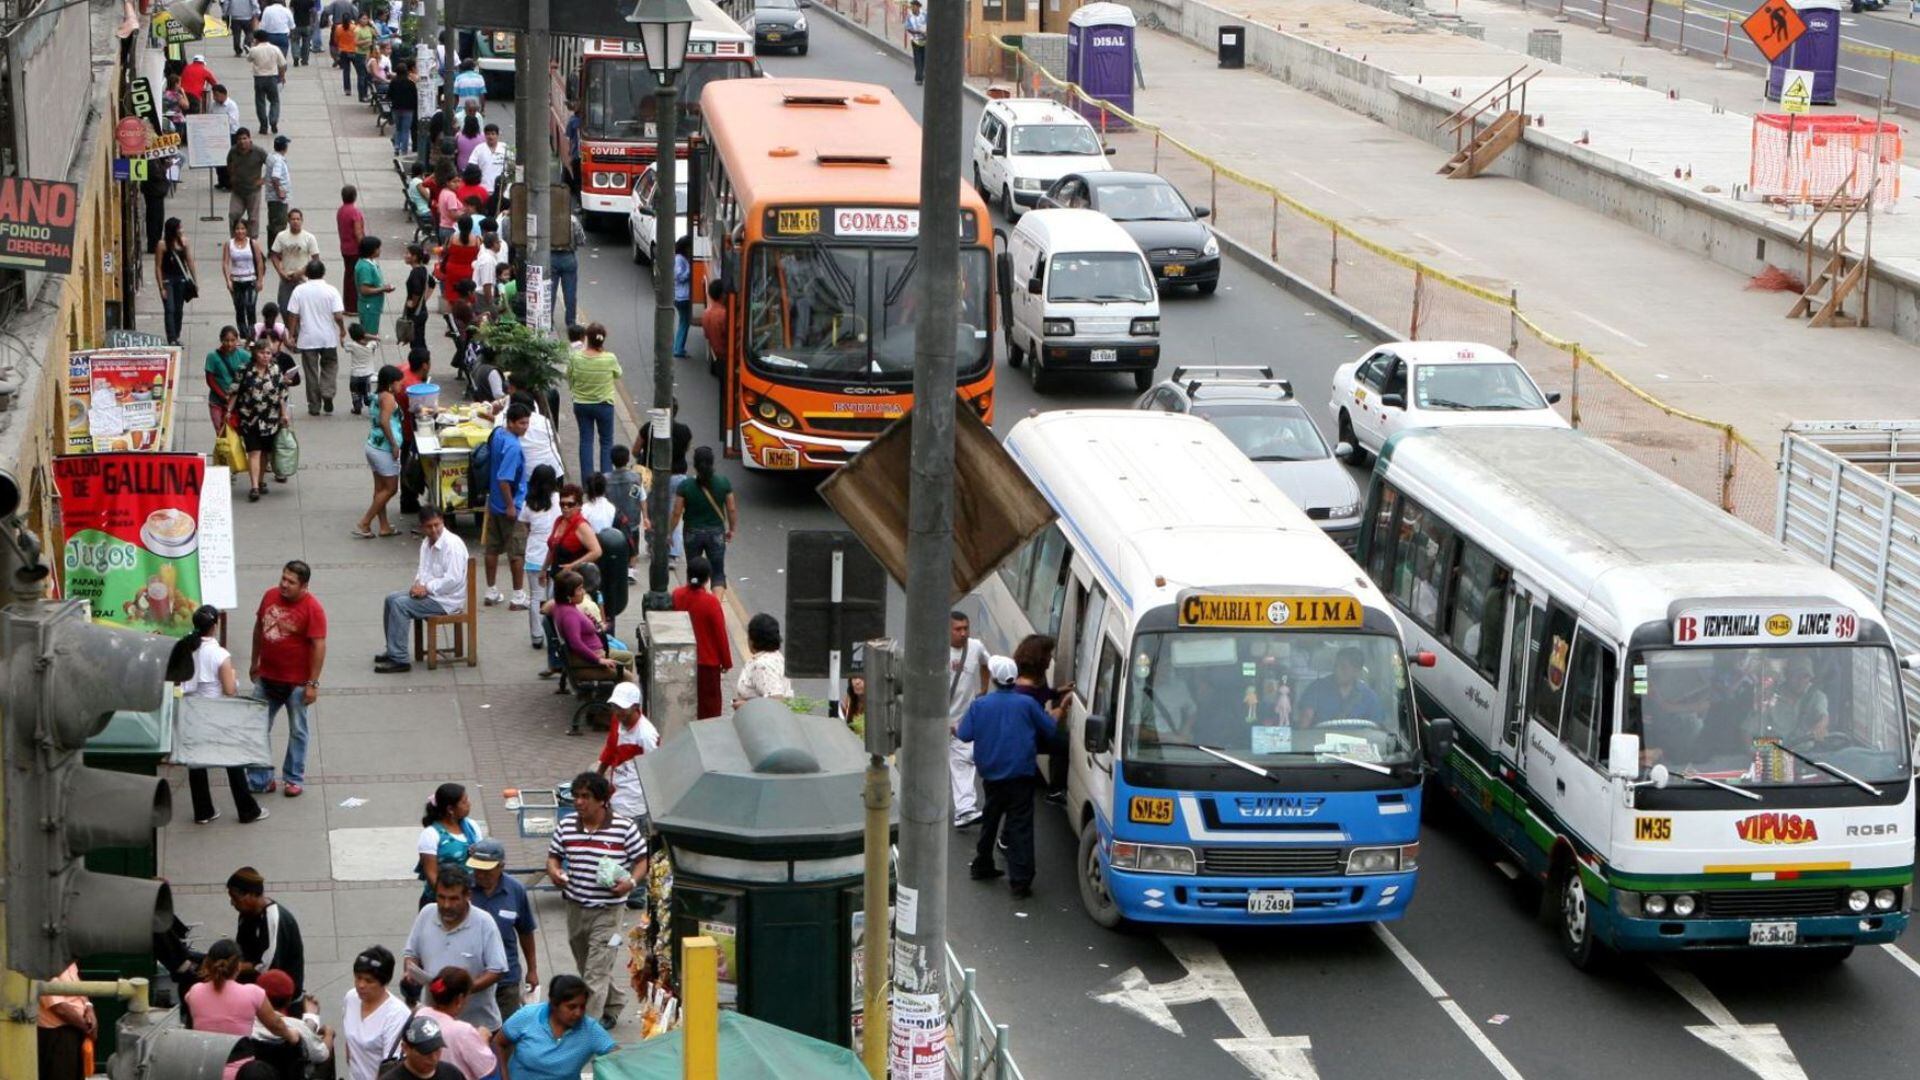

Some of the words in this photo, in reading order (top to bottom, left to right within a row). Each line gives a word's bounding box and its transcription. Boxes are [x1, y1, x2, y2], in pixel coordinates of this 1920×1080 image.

[1093, 36, 1125, 47] DISAL
[145, 147, 176, 158] FOTO
[590, 147, 626, 155] COVIDA
[0, 223, 50, 240] FONDO
[7, 238, 71, 258] DERECHA
[1457, 351, 1475, 359] TAXI
[843, 386, 897, 395] COMIL
[55, 458, 100, 478] CALDO
[73, 479, 90, 498] DE
[103, 462, 200, 496] GALLINA
[66, 540, 136, 573] Jugos
[1295, 602, 1358, 622] LIMA
[1678, 616, 1697, 642] B
[1703, 615, 1760, 637] VENTANILLA
[1797, 613, 1832, 636] LINCE
[1835, 614, 1856, 639] 39
[1735, 812, 1818, 843] VIPUSA
[1846, 823, 1899, 837] ROSA
